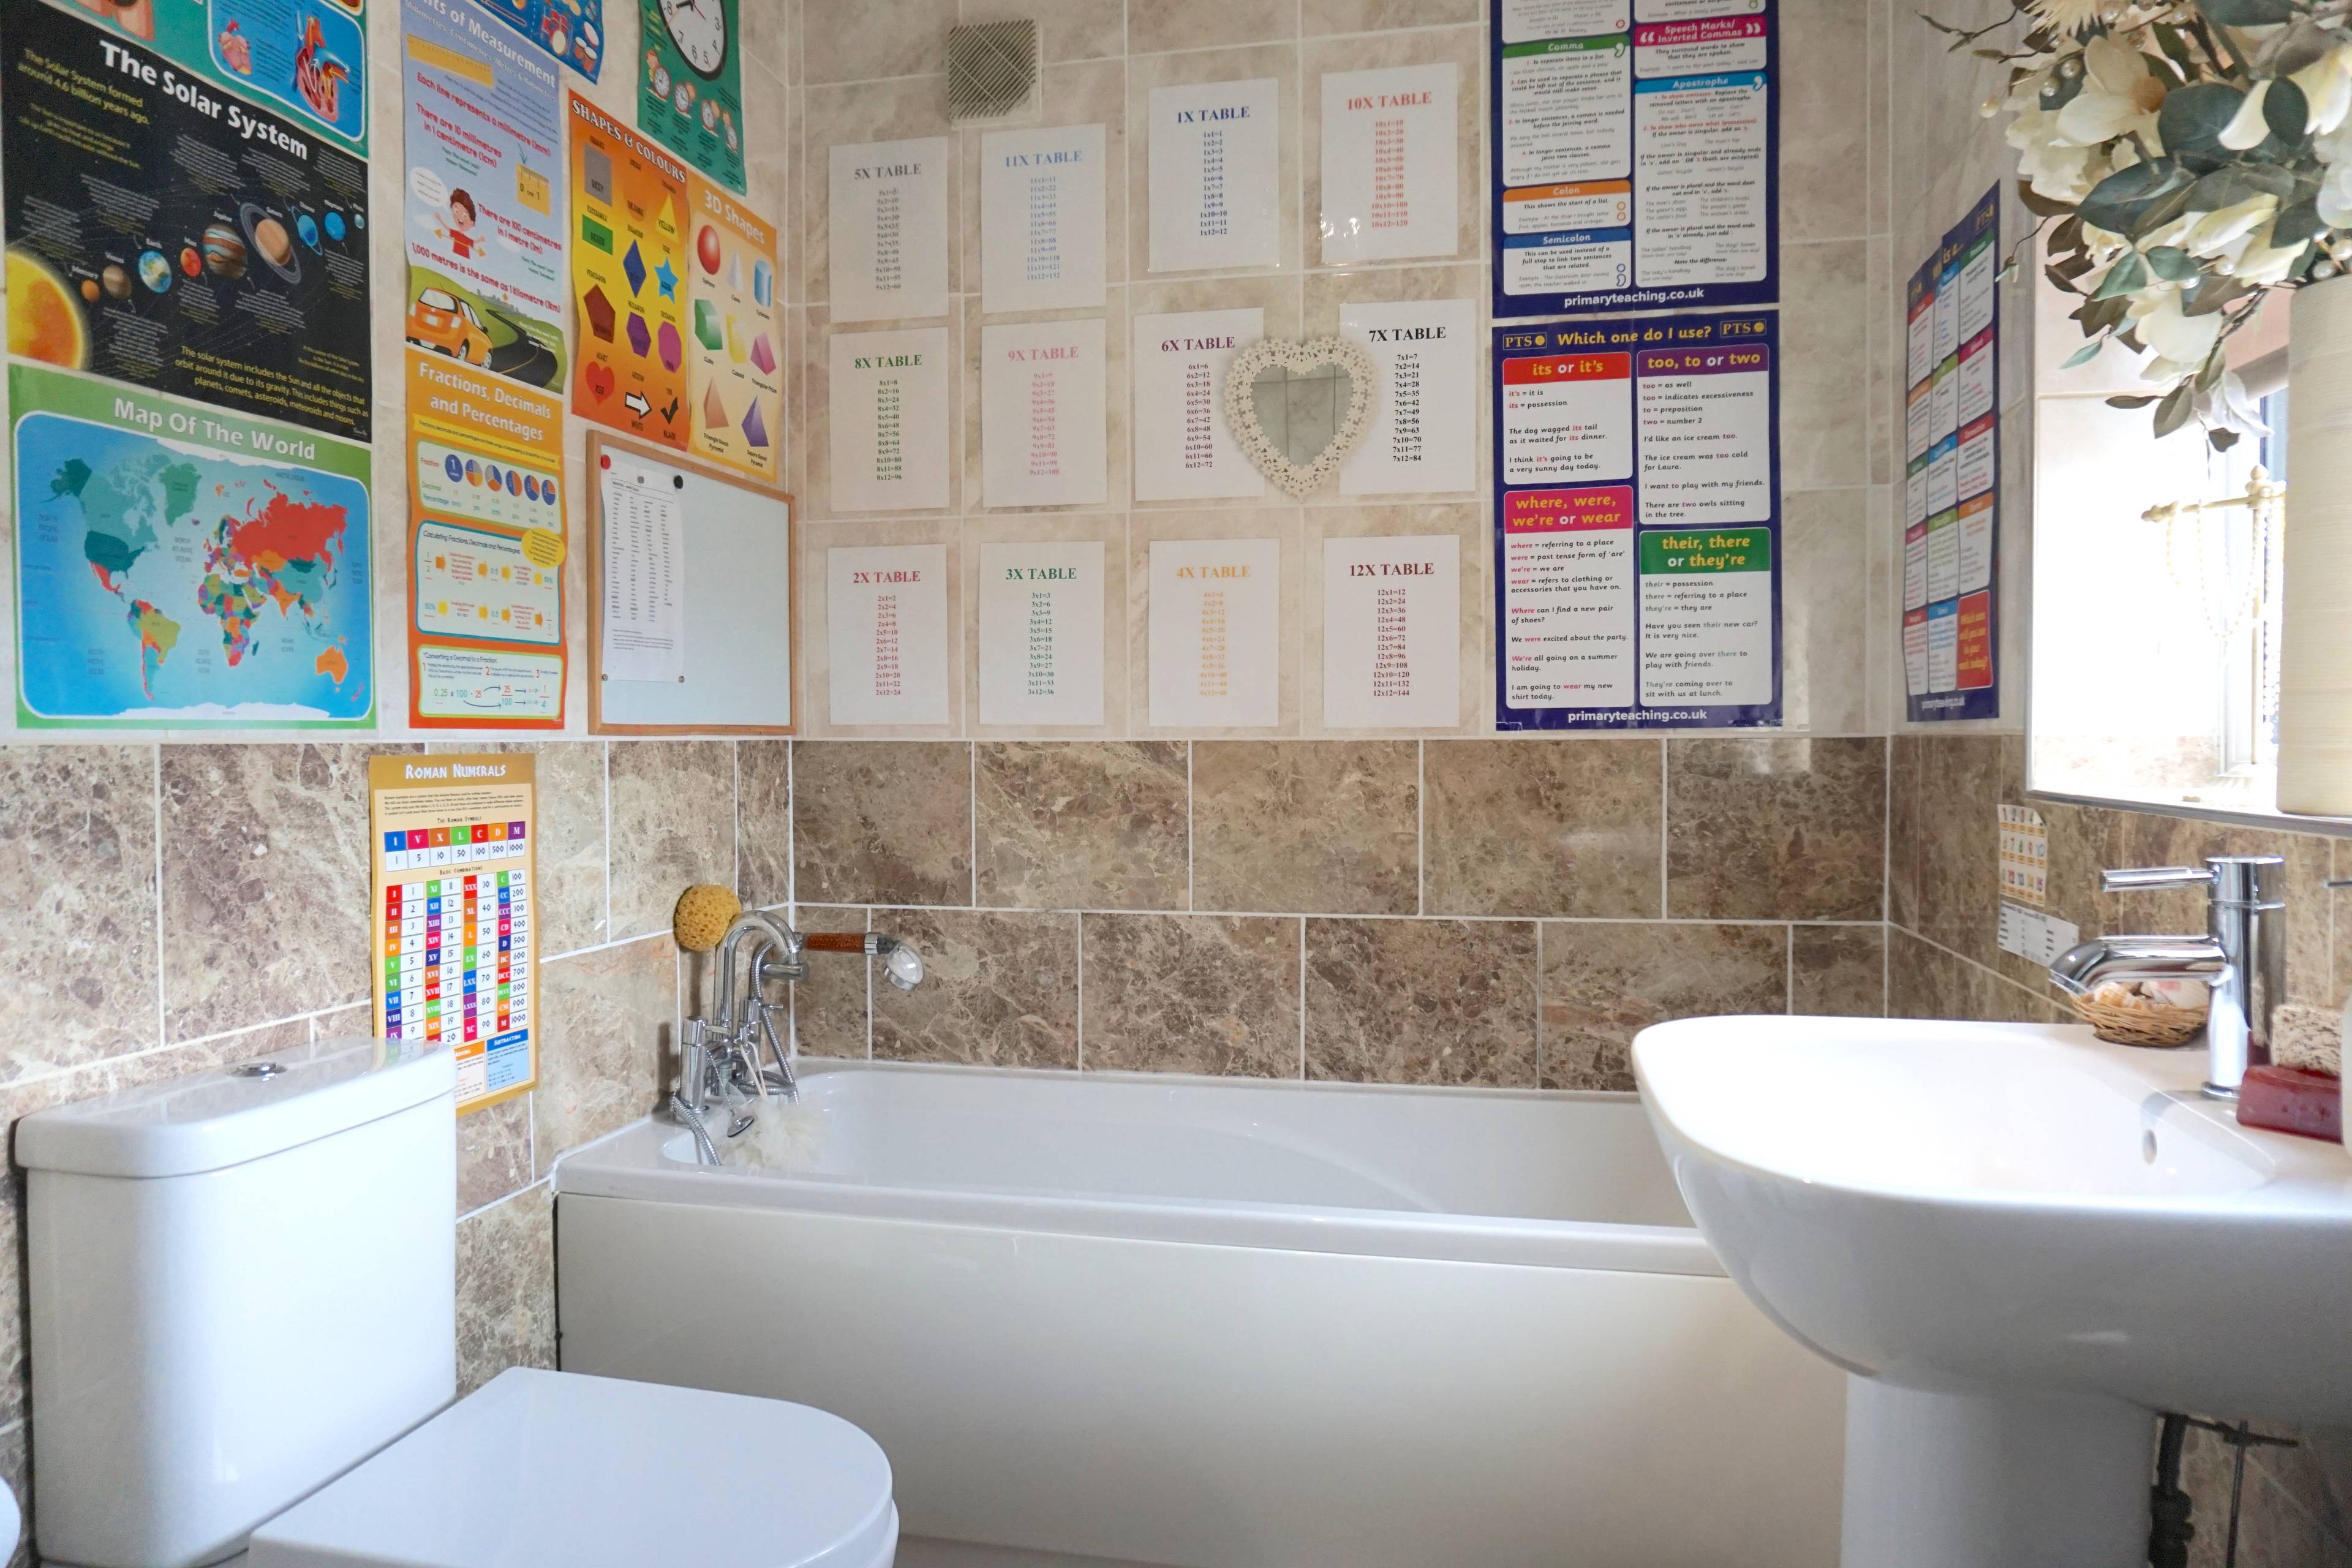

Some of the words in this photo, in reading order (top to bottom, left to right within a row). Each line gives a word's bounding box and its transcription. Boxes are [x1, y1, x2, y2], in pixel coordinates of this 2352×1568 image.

[666, 1, 673, 15] 8
[715, 17, 720, 31] 3
[1665, 23, 1698, 37] Speech
[1701, 19, 1735, 31] Marks/
[678, 31, 684, 43] 7
[1658, 31, 1697, 43] Inverted
[1700, 29, 1742, 39] Commas
[450, 11, 466, 27] of
[469, 18, 556, 88] Measurement
[692, 45, 698, 59] 6
[712, 39, 720, 55] 4
[1548, 43, 1583, 51] Comma
[703, 50, 710, 69] 5
[1672, 77, 1729, 89] Apostrophe
[99, 40, 157, 86] The
[162, 71, 222, 119] Solar
[228, 105, 307, 160] System
[1349, 97, 1373, 110] 10X
[1378, 92, 1431, 107] TABLE
[1178, 111, 1193, 123] 1X
[1199, 107, 1249, 121] TABLE
[572, 99, 622, 141] SHAPES
[624, 132, 633, 148] &
[636, 141, 686, 184] COLOURS
[1006, 155, 1028, 167] 11X
[1033, 150, 1083, 165] TABLE
[855, 168, 870, 179] 5X
[875, 164, 921, 178] TABLE
[1553, 186, 1580, 195] Colon
[704, 190, 722, 214] 3D
[725, 204, 765, 244] Shapes
[1543, 233, 1591, 244] Semicolon
[412, 243, 429, 258] 1,000
[431, 252, 458, 270] metres
[459, 263, 465, 273] is
[467, 267, 480, 279] the
[480, 274, 499, 288] same
[500, 283, 508, 292] as
[510, 284, 512, 293] 1
[513, 286, 544, 307] kilometre
[545, 300, 560, 313] (1km)
[1564, 287, 1704, 308] primaryteaching.co.uk
[1369, 330, 1387, 342] 7X
[1392, 327, 1446, 341] TABLE
[1558, 331, 1606, 345] Which
[1611, 333, 1638, 343] one
[1644, 328, 1662, 341] do
[1668, 328, 1673, 339] I
[1679, 326, 1711, 338] use?
[1723, 323, 1751, 334] PTS
[1162, 340, 1179, 352] 6X
[1184, 337, 1235, 350] TABLE
[1506, 336, 1532, 347] PTS
[704, 356, 715, 366] Cube
[1008, 350, 1025, 361] 9X
[1030, 347, 1078, 360] TABLE
[1648, 358, 1678, 369] too,
[1685, 356, 1700, 367] to
[1707, 356, 1724, 366] or
[1730, 353, 1760, 364] two
[855, 358, 871, 369] 8X
[875, 355, 922, 368] TABLE
[1533, 364, 1551, 375] its
[1558, 364, 1574, 373] or
[1580, 360, 1603, 372] it's
[181, 346, 195, 358] The
[197, 350, 214, 363] solar
[216, 356, 242, 371] system
[244, 363, 274, 379] includes
[276, 372, 287, 382] the
[288, 375, 300, 385] Sun
[300, 379, 312, 390] and
[322, 385, 332, 395] the
[333, 387, 352, 402] objects
[353, 395, 365, 405] that
[732, 369, 745, 379] Cuboid
[419, 361, 490, 401] Fractions,
[494, 387, 551, 419] Decimals
[430, 396, 458, 415] and
[462, 402, 543, 442] Percentages
[113, 397, 163, 433] Map
[168, 412, 197, 435] Of
[202, 419, 244, 447] The
[251, 429, 315, 461] World
[1541, 425, 1570, 434] wagged
[1517, 496, 1567, 509] where,
[1574, 495, 1617, 510] were,
[1513, 514, 1553, 526] we're
[1560, 516, 1576, 524] or
[1582, 513, 1621, 523] wear
[1662, 537, 1703, 551] their,
[1709, 535, 1750, 548] there
[1668, 558, 1684, 567] or
[1689, 553, 1745, 569] they're
[853, 573, 869, 583] 2X
[873, 571, 920, 582] TABLE
[1006, 569, 1023, 579] 3X
[1028, 568, 1076, 579] TABLE
[1177, 567, 1194, 578] 4X
[1199, 566, 1250, 578] TABLE
[1351, 565, 1376, 576] 12X
[1381, 563, 1434, 575] TABLE
[1568, 709, 1708, 723] primaryteaching.co.uk
[405, 764, 447, 780] ROMAN
[453, 764, 506, 778] NUMERALS
[393, 837, 398, 846] I
[415, 835, 421, 843] V
[437, 833, 443, 842] X
[477, 829, 483, 839] C
[513, 826, 520, 835] M
[396, 856, 398, 864] 1
